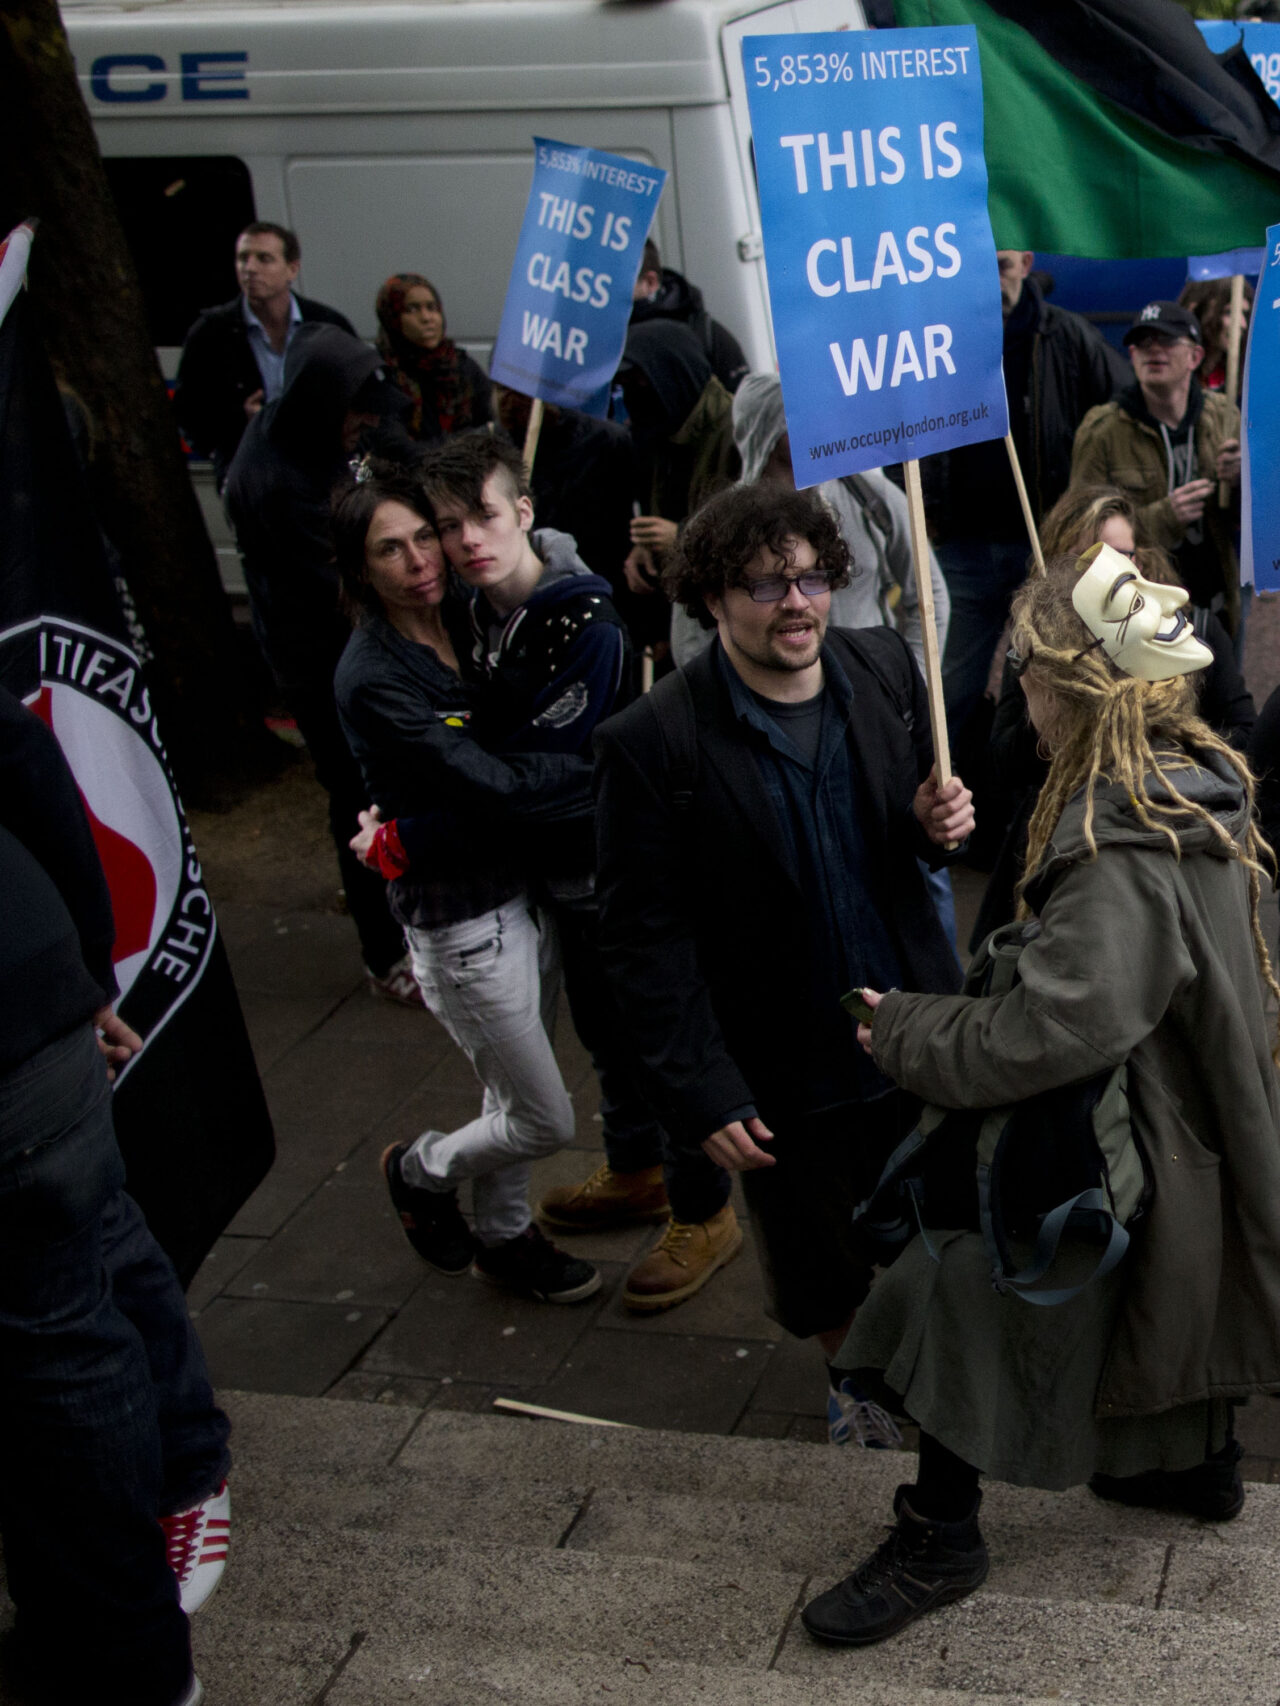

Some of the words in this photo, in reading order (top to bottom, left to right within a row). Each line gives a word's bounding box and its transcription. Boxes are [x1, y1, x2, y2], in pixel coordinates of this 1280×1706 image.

[755, 52, 853, 92] 5,853%
[862, 47, 970, 80] INTEREST
[583, 161, 658, 197] INTEREST
[780, 126, 905, 194] THIS
[920, 121, 962, 180] IS
[538, 192, 595, 240] THIS
[601, 212, 632, 251] IS
[527, 253, 612, 308] CLASS
[806, 223, 961, 297] CLASS
[521, 311, 588, 366] WAR
[829, 324, 956, 396] WAR
[809, 403, 989, 460] www.occupylondon.org.uk
